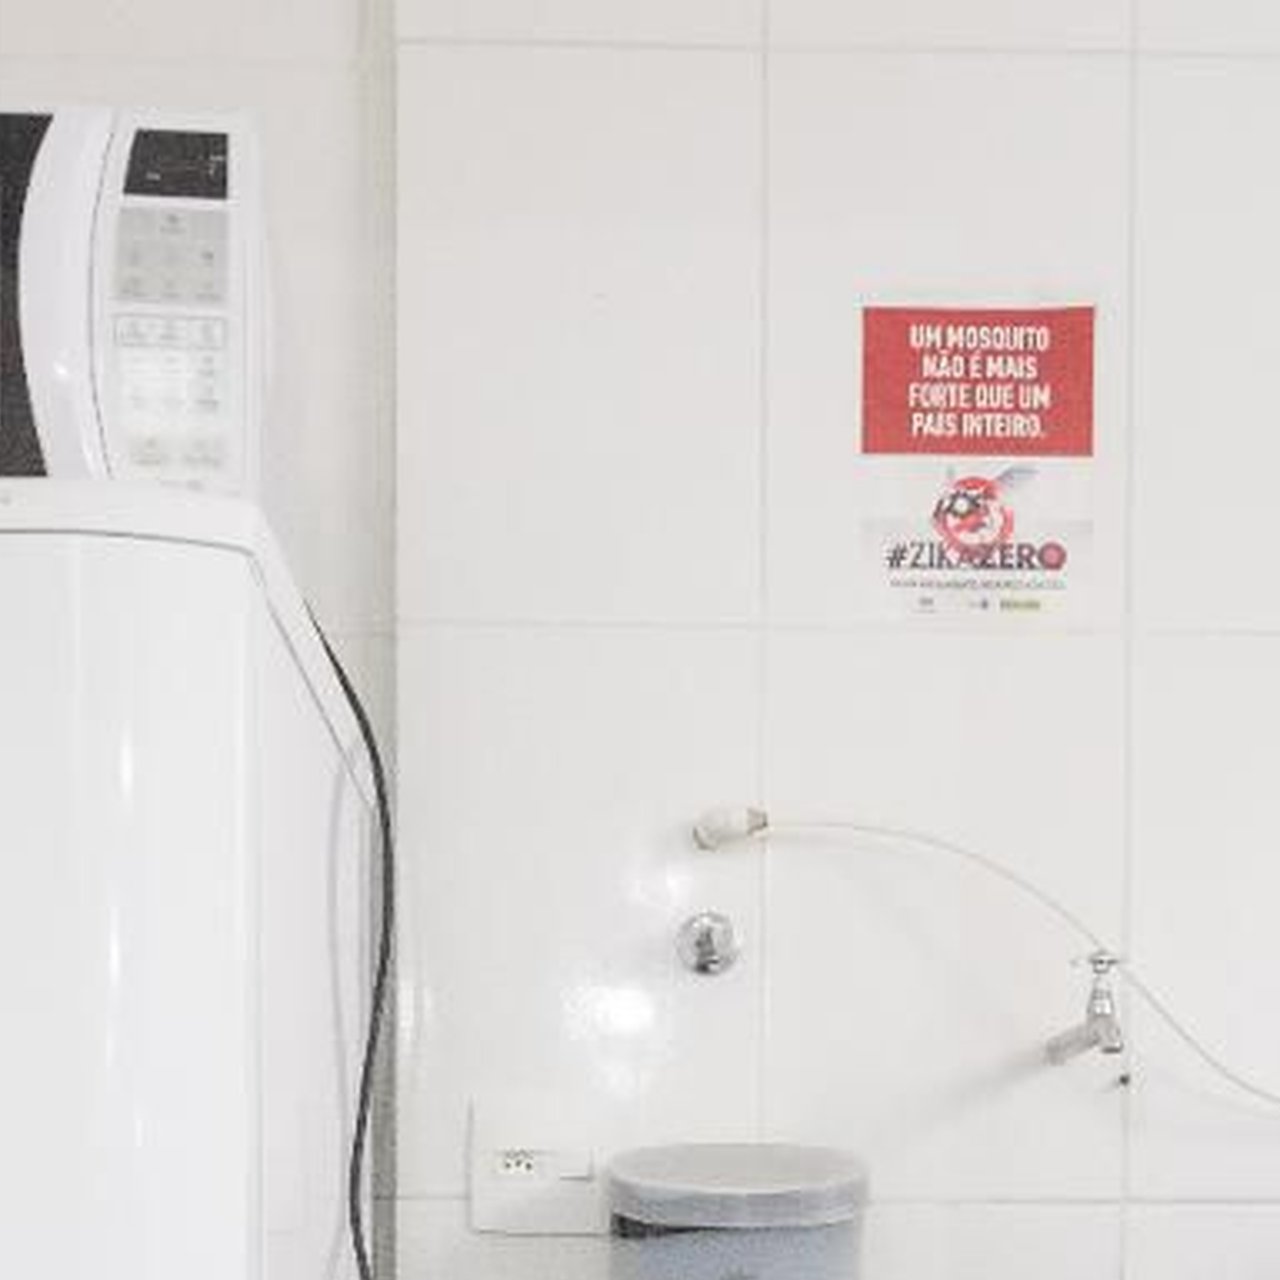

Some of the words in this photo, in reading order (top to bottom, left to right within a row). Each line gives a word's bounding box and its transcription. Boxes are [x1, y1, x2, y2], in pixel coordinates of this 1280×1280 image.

[909, 324, 942, 349] UM
[946, 325, 1051, 351] MOSQUITO
[922, 348, 965, 378] NÃO
[969, 349, 983, 378] É
[986, 355, 1039, 379] MAIS
[908, 382, 973, 408] FORTE
[975, 382, 1015, 409] QUE
[1018, 383, 1051, 409] UM
